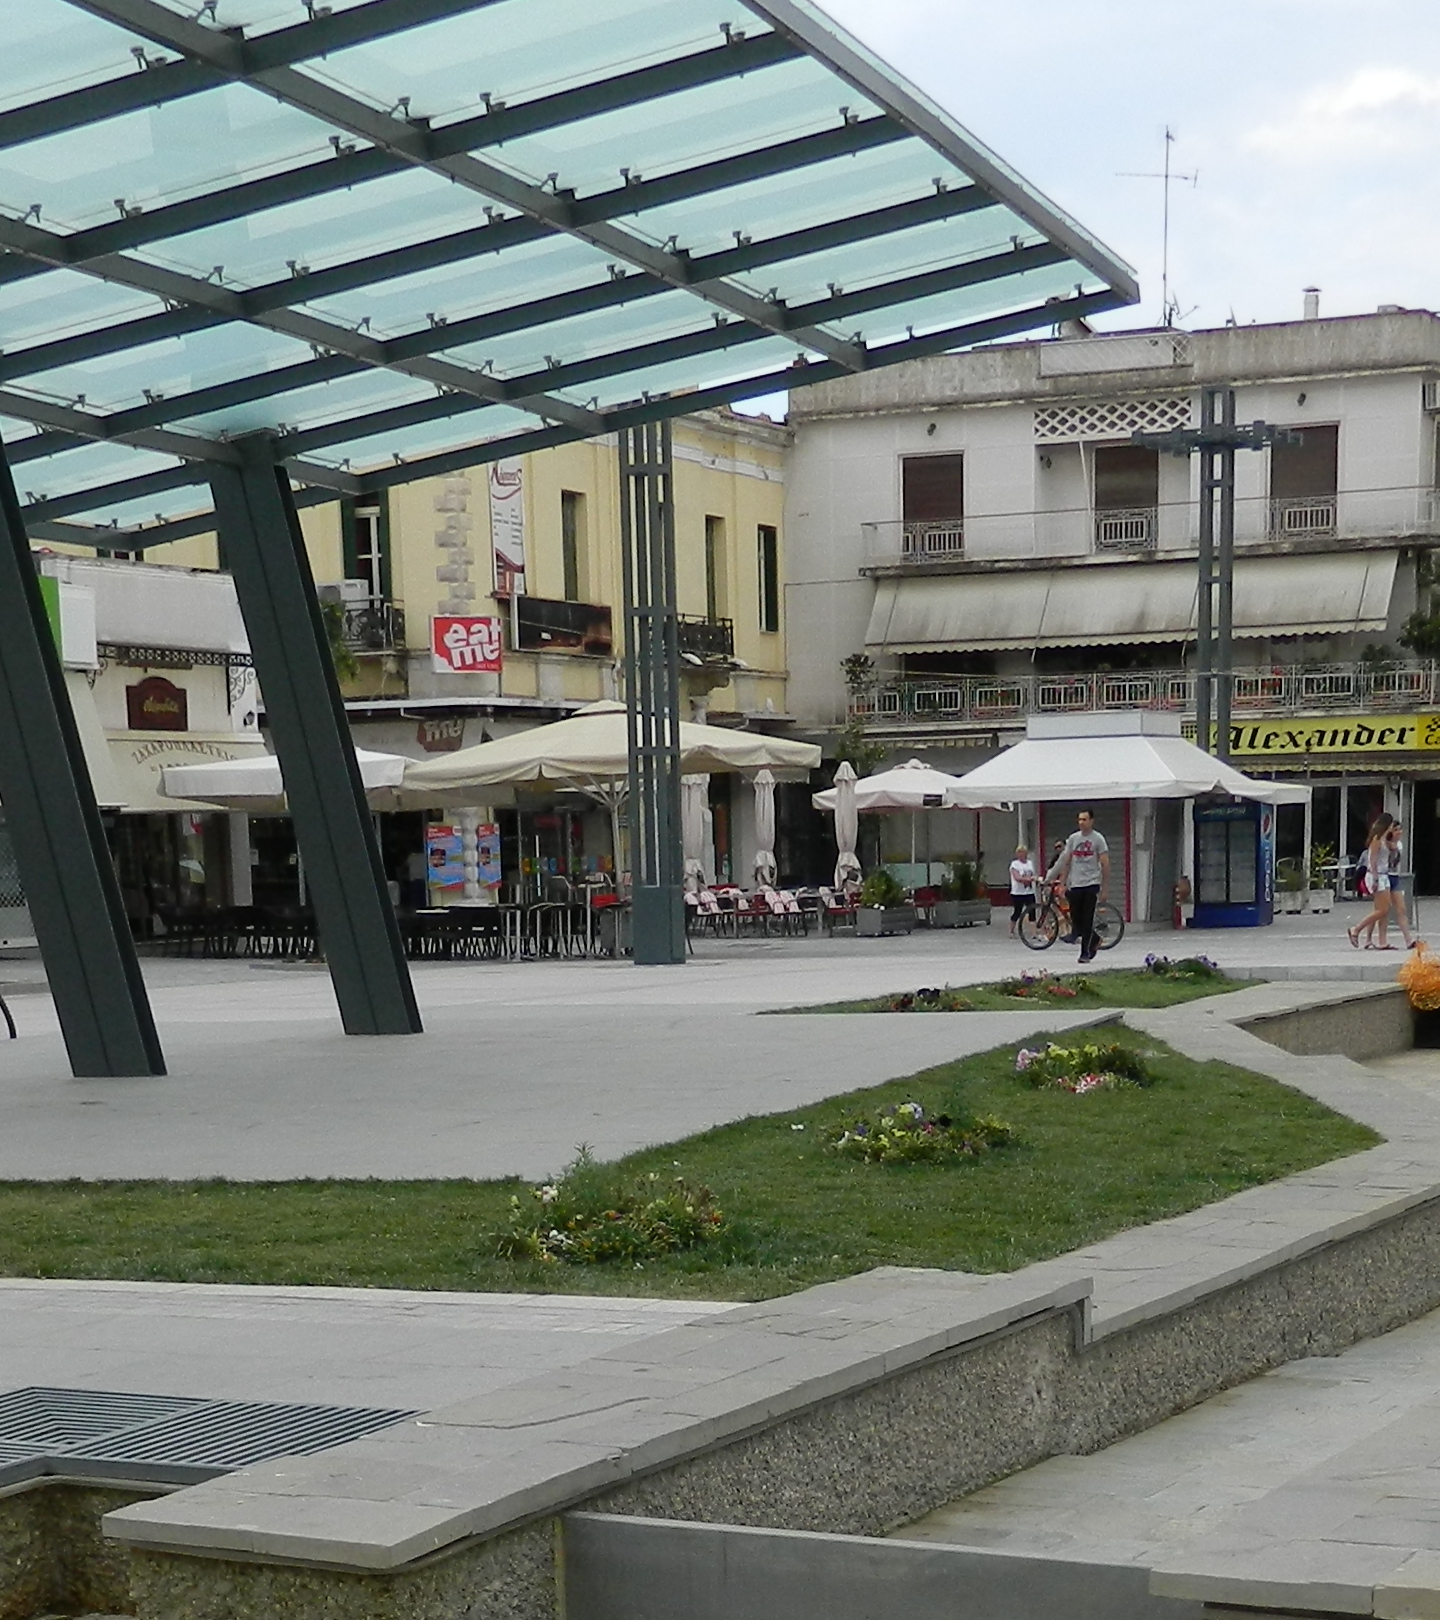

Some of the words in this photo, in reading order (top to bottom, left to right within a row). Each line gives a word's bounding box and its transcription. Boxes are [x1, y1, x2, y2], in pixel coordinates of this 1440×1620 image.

[443, 617, 502, 649] eat
[449, 641, 501, 668] me
[1211, 723, 1415, 750] Alexander
